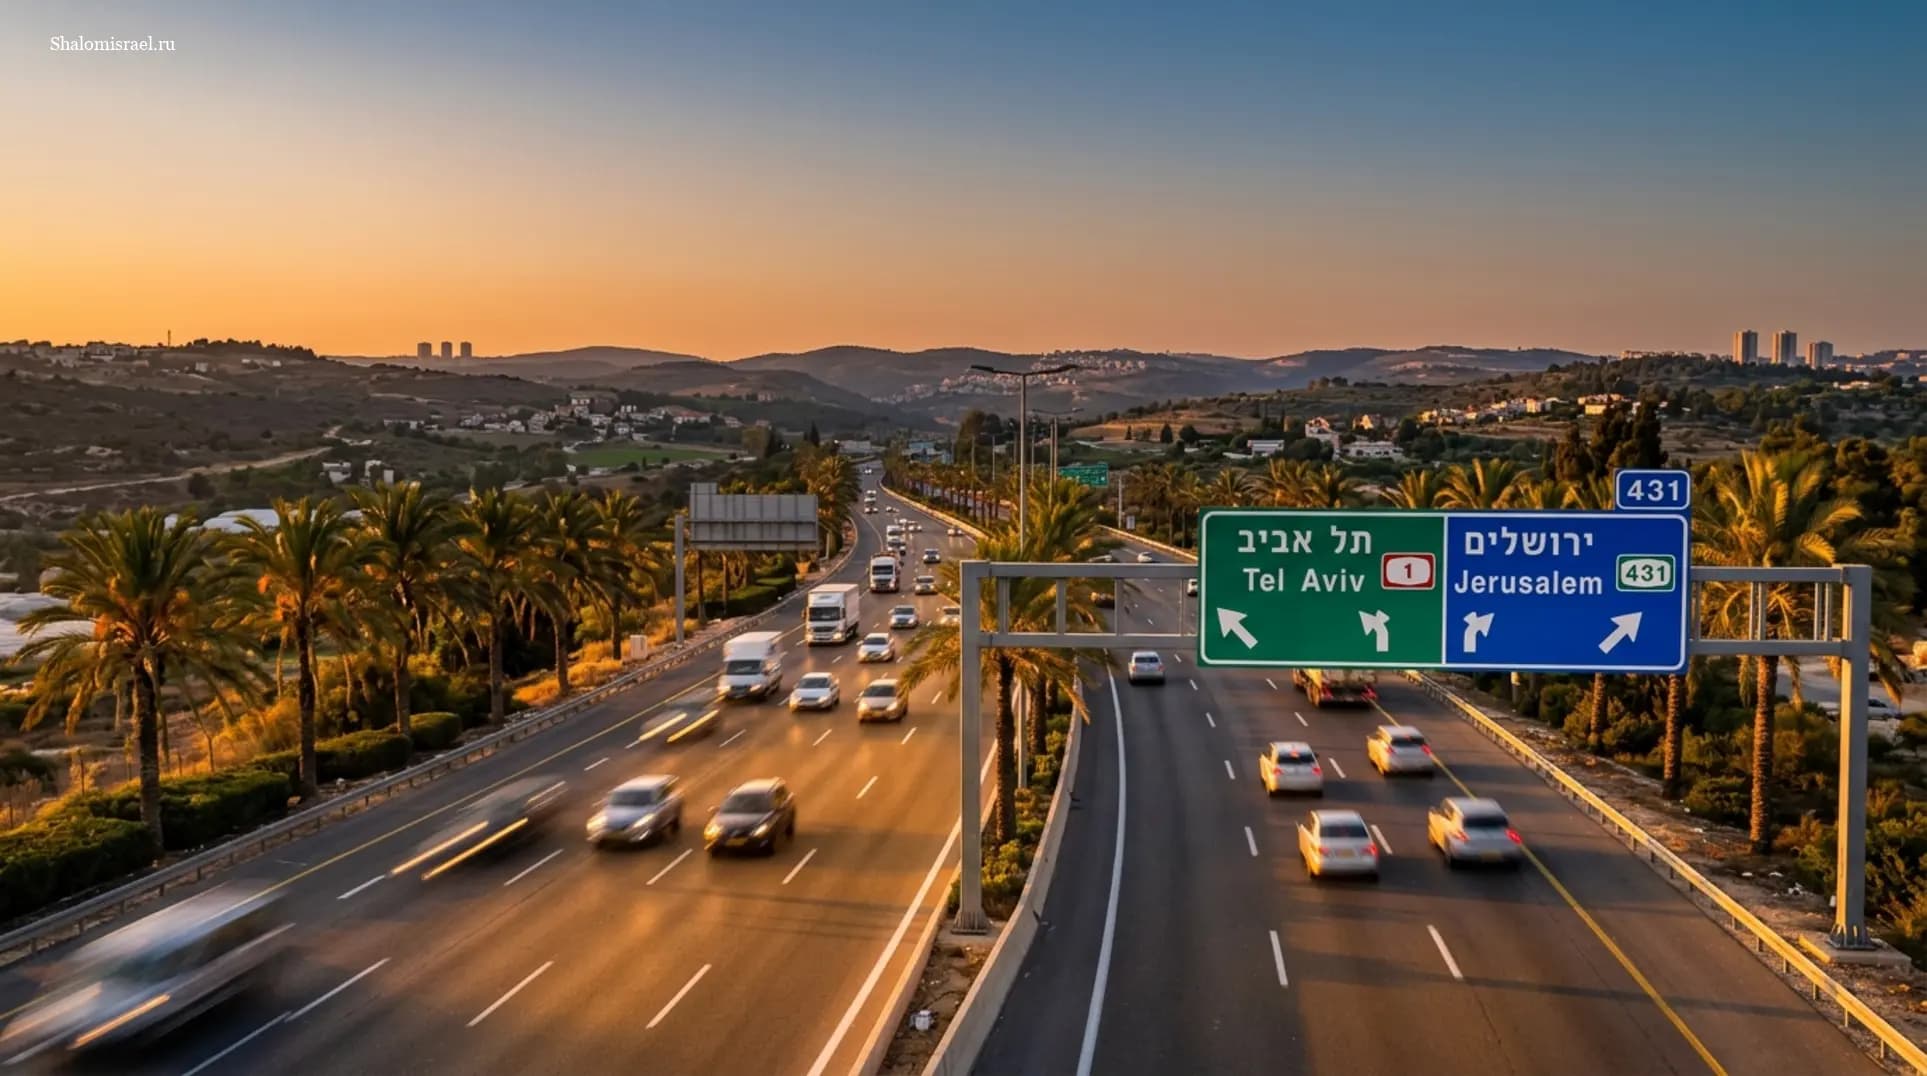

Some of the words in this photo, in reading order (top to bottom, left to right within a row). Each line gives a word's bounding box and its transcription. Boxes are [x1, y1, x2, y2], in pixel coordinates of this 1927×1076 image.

[1626, 480, 1682, 501] 431
[1237, 529, 1313, 554] אביב
[1330, 526, 1372, 554] תל
[1464, 528, 1594, 555] ירושלים
[1242, 568, 1284, 592] Tel
[1301, 568, 1365, 592] Aviv
[1402, 563, 1413, 580] 1
[1454, 570, 1602, 595] Jerusalem
[1625, 564, 1667, 582] 431
